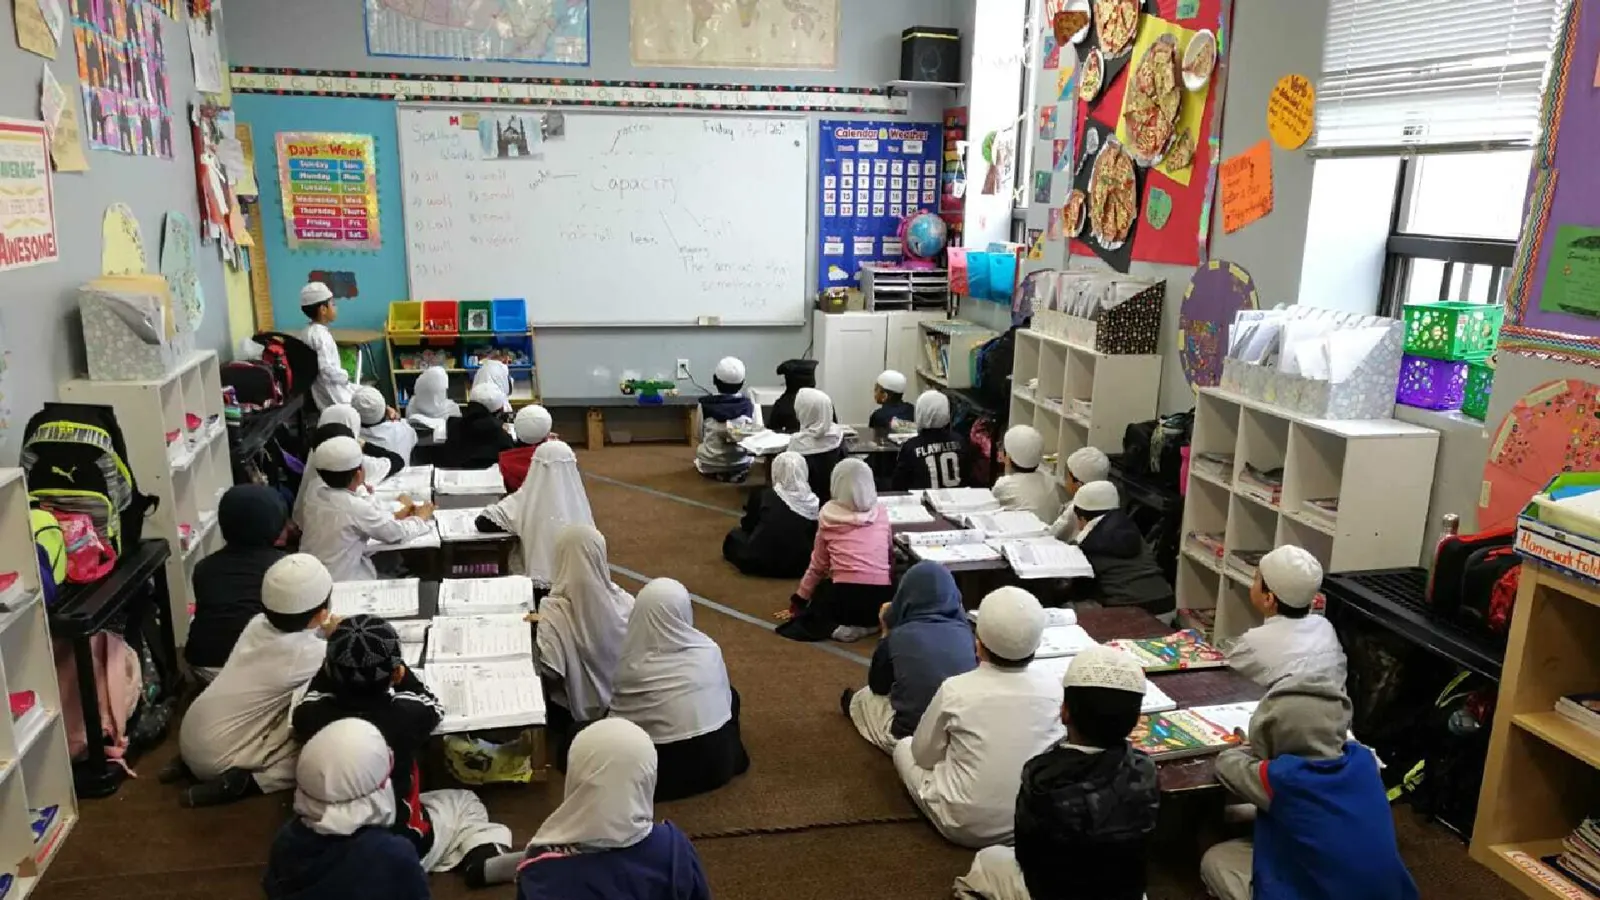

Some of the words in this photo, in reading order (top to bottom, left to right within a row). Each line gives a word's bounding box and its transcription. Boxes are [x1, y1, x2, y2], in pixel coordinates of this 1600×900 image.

[836, 127, 878, 139] Calendar
[289, 144, 319, 156] Days
[328, 143, 362, 157] Week
[300, 160, 329, 169] Sunday
[299, 172, 331, 181] Monday
[300, 184, 332, 192] Tuesday
[300, 207, 336, 216] Thursday
[306, 219, 331, 227] Friday
[302, 229, 337, 239] Saturday
[0, 232, 57, 266] AWESOME
[925, 451, 961, 489] 10
